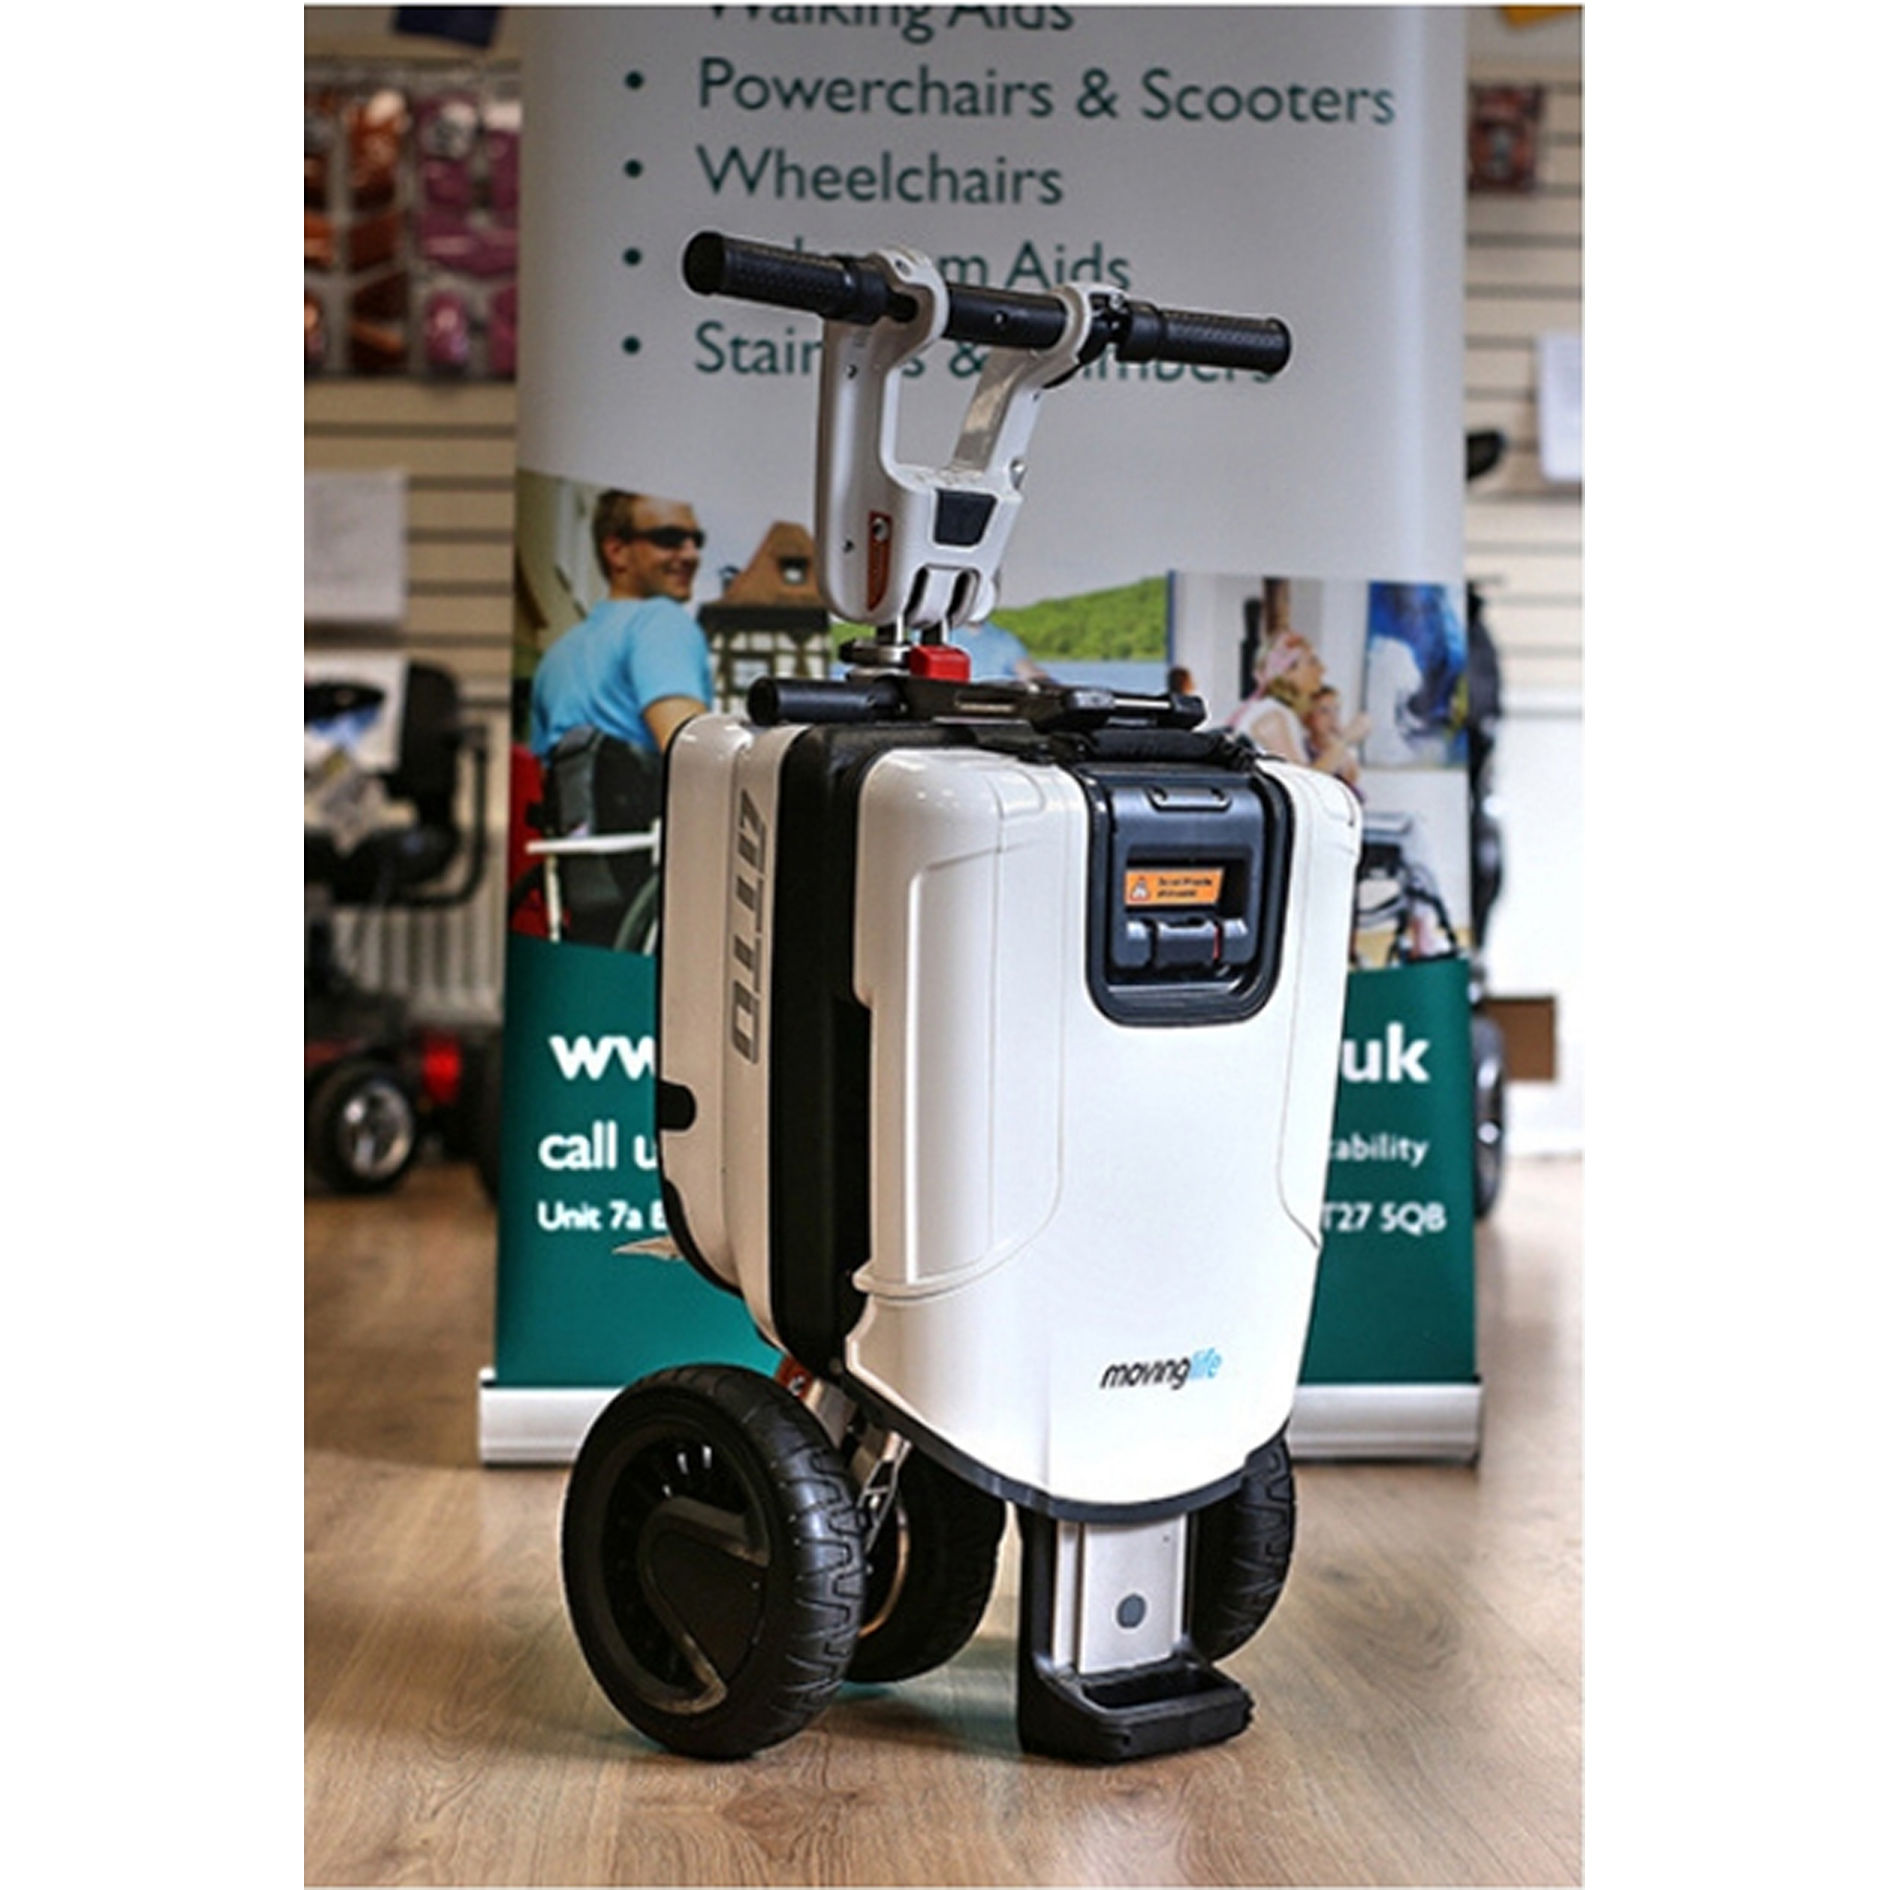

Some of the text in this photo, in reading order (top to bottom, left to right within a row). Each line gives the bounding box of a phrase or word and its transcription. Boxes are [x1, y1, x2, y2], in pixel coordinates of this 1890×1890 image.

[704, 4, 935, 44] aking
[699, 57, 1396, 125] Powerchairs & Scooters
[696, 146, 1064, 204] Wheelchairs
[1006, 241, 1131, 290] Aids
[1341, 1021, 1430, 1082] uk
[538, 1120, 618, 1169] call
[1331, 1132, 1429, 1168] ability
[537, 1201, 602, 1231] Unit
[609, 1201, 643, 1230] 7a
[1099, 1347, 1222, 1390] movinglife
